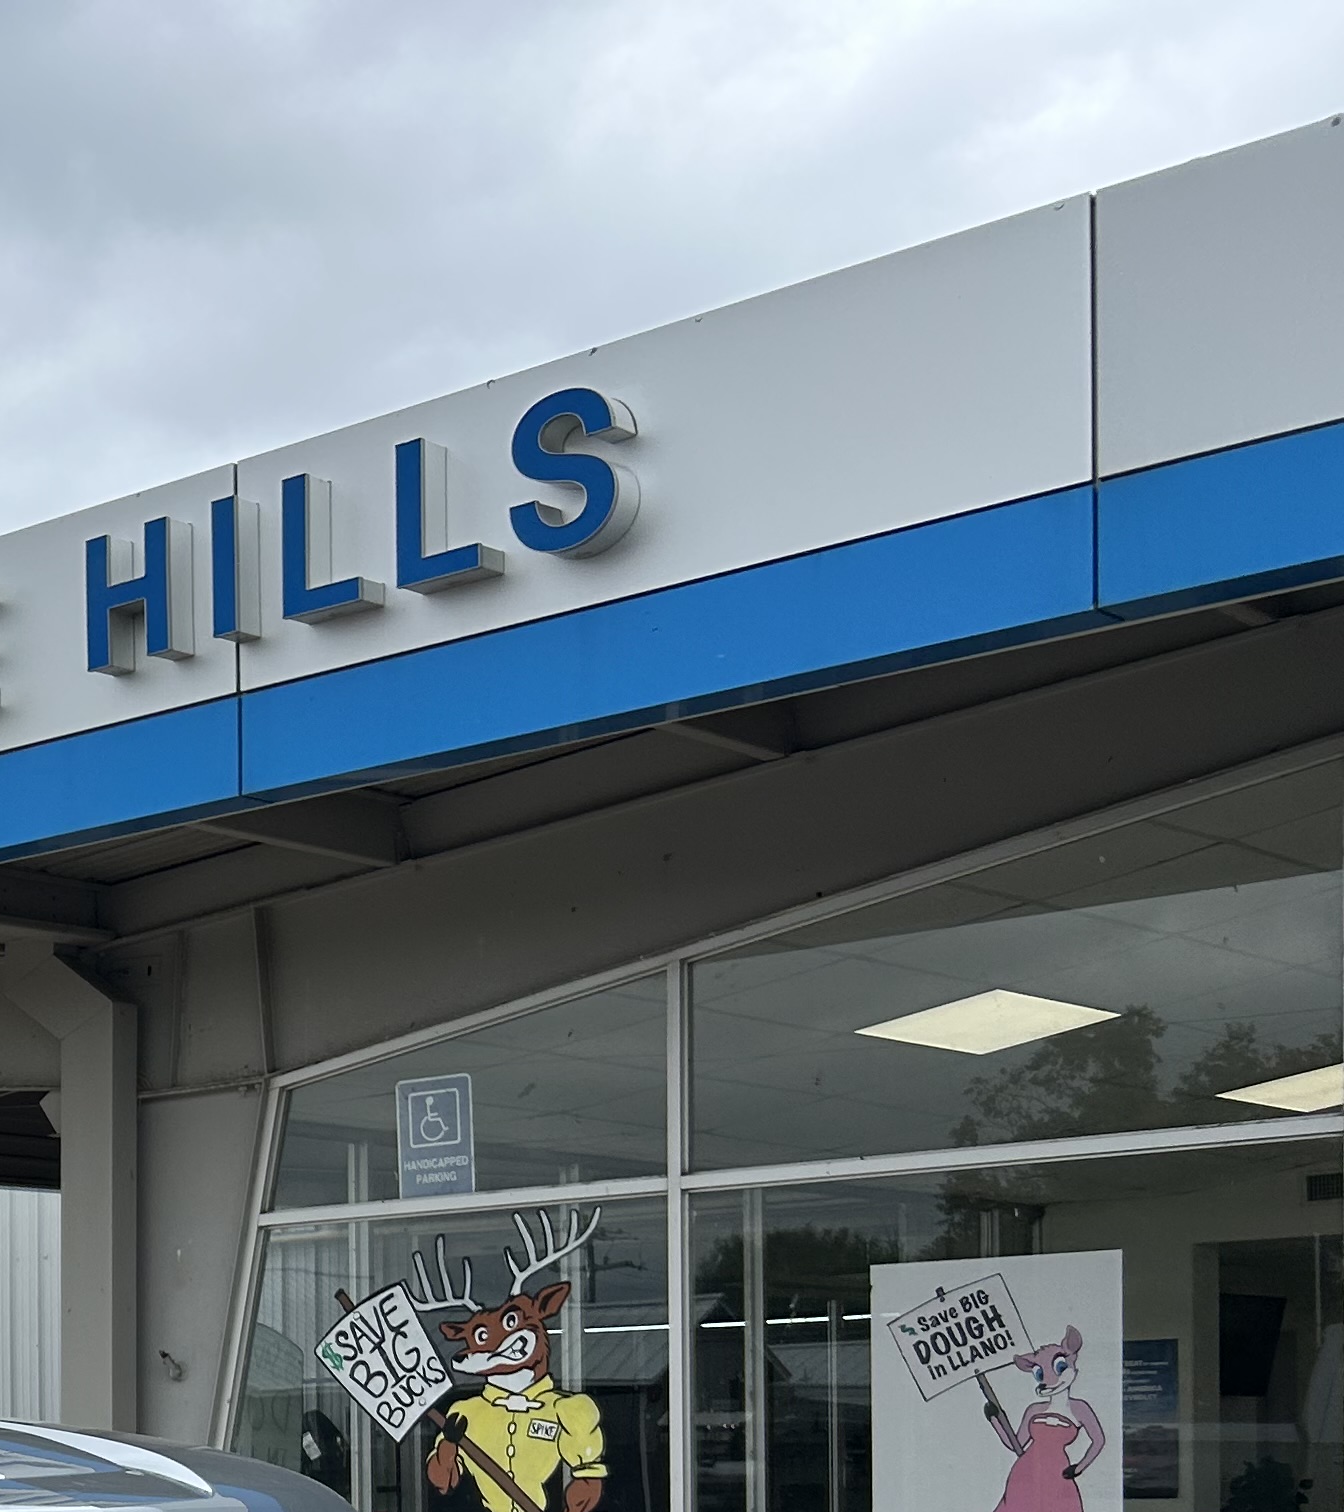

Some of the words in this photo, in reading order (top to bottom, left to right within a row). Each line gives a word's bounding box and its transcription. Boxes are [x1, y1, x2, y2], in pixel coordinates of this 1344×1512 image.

[84, 387, 638, 676] HILLS
[403, 1155, 469, 1171] HANDICAPPED
[415, 1170, 457, 1185] PARKING
[335, 1293, 409, 1361] SAVE
[912, 1304, 1006, 1365] DOUGH
[916, 1307, 959, 1332] Save
[958, 1289, 990, 1313] BIG
[349, 1330, 421, 1398] BIG
[927, 1364, 948, 1380] in
[947, 1329, 1016, 1371] LLANO!
[376, 1356, 447, 1428] BUCKS
